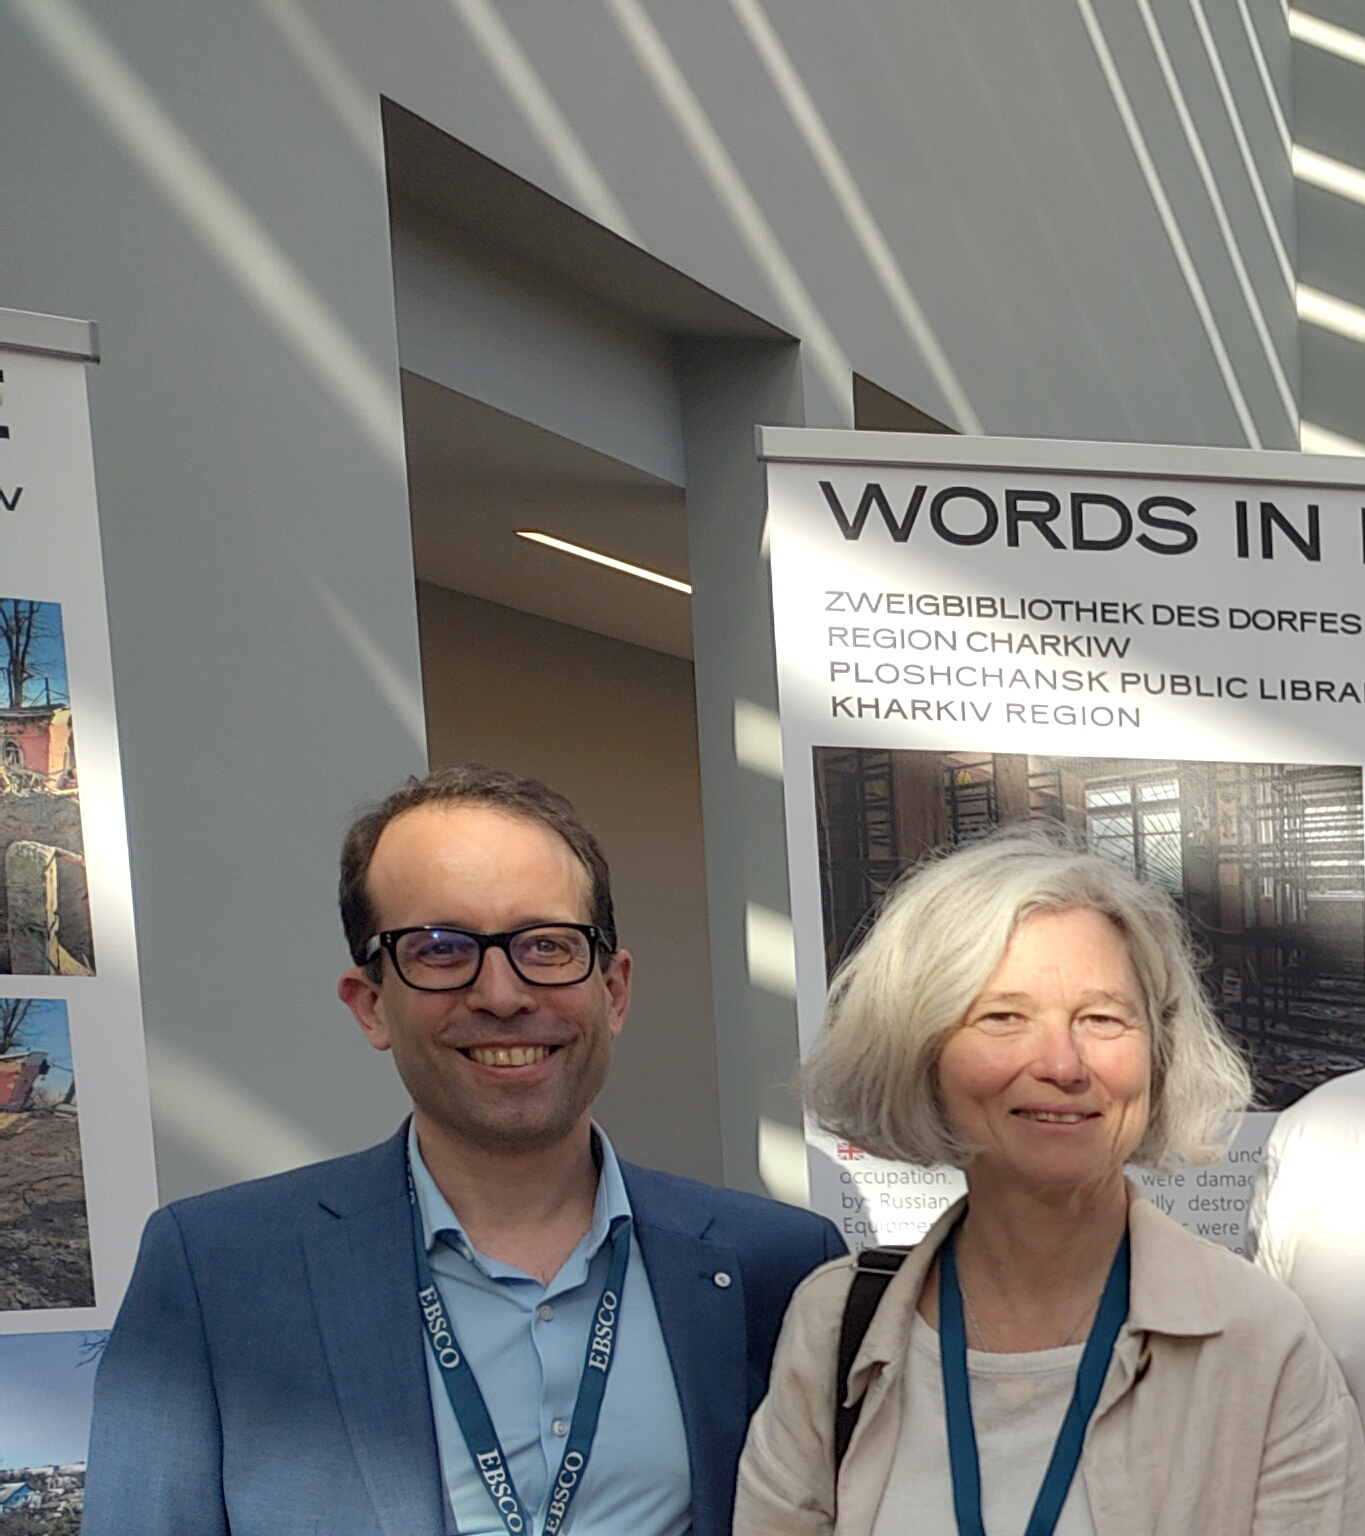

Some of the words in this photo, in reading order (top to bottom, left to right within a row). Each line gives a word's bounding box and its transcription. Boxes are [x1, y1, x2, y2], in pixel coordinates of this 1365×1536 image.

[819, 480, 1198, 555] WORDS
[1236, 500, 1321, 562] IN
[824, 590, 1144, 625] ZWEIGBIBLIOTHEK
[1152, 603, 1219, 628] DES
[1229, 606, 1362, 634] DORFES
[827, 626, 957, 652] REGION
[965, 631, 1131, 659] CHARKIW
[830, 661, 1109, 693] PLOSHCHANSK
[1120, 672, 1248, 698] PUBLIC
[831, 695, 992, 722] KHARKIV
[1005, 702, 1141, 728] REGION
[840, 1171, 952, 1187] occupation.
[842, 1193, 863, 1213] by
[1197, 1222, 1239, 1235] were
[417, 1284, 460, 1370] EBSCO
[589, 1290, 618, 1373] EBSCO
[476, 1448, 524, 1534] EBSCO
[544, 1451, 585, 1536] EBSCO
